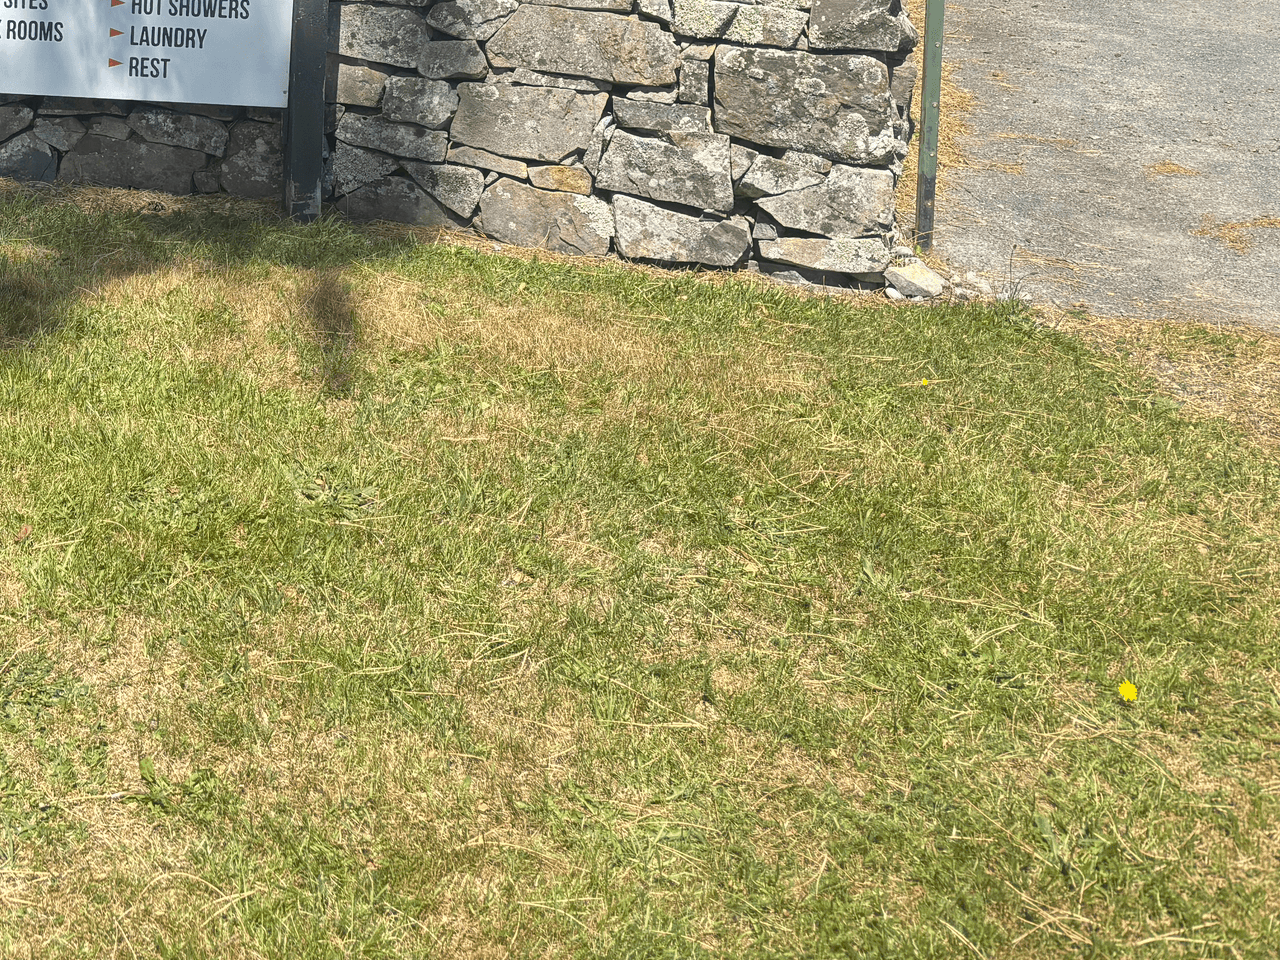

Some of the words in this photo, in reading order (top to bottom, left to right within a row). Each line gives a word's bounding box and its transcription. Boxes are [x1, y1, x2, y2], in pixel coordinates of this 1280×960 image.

[6, 19, 64, 42] ROOMS
[130, 26, 208, 49] LAUNDRY
[128, 57, 171, 79] REST
